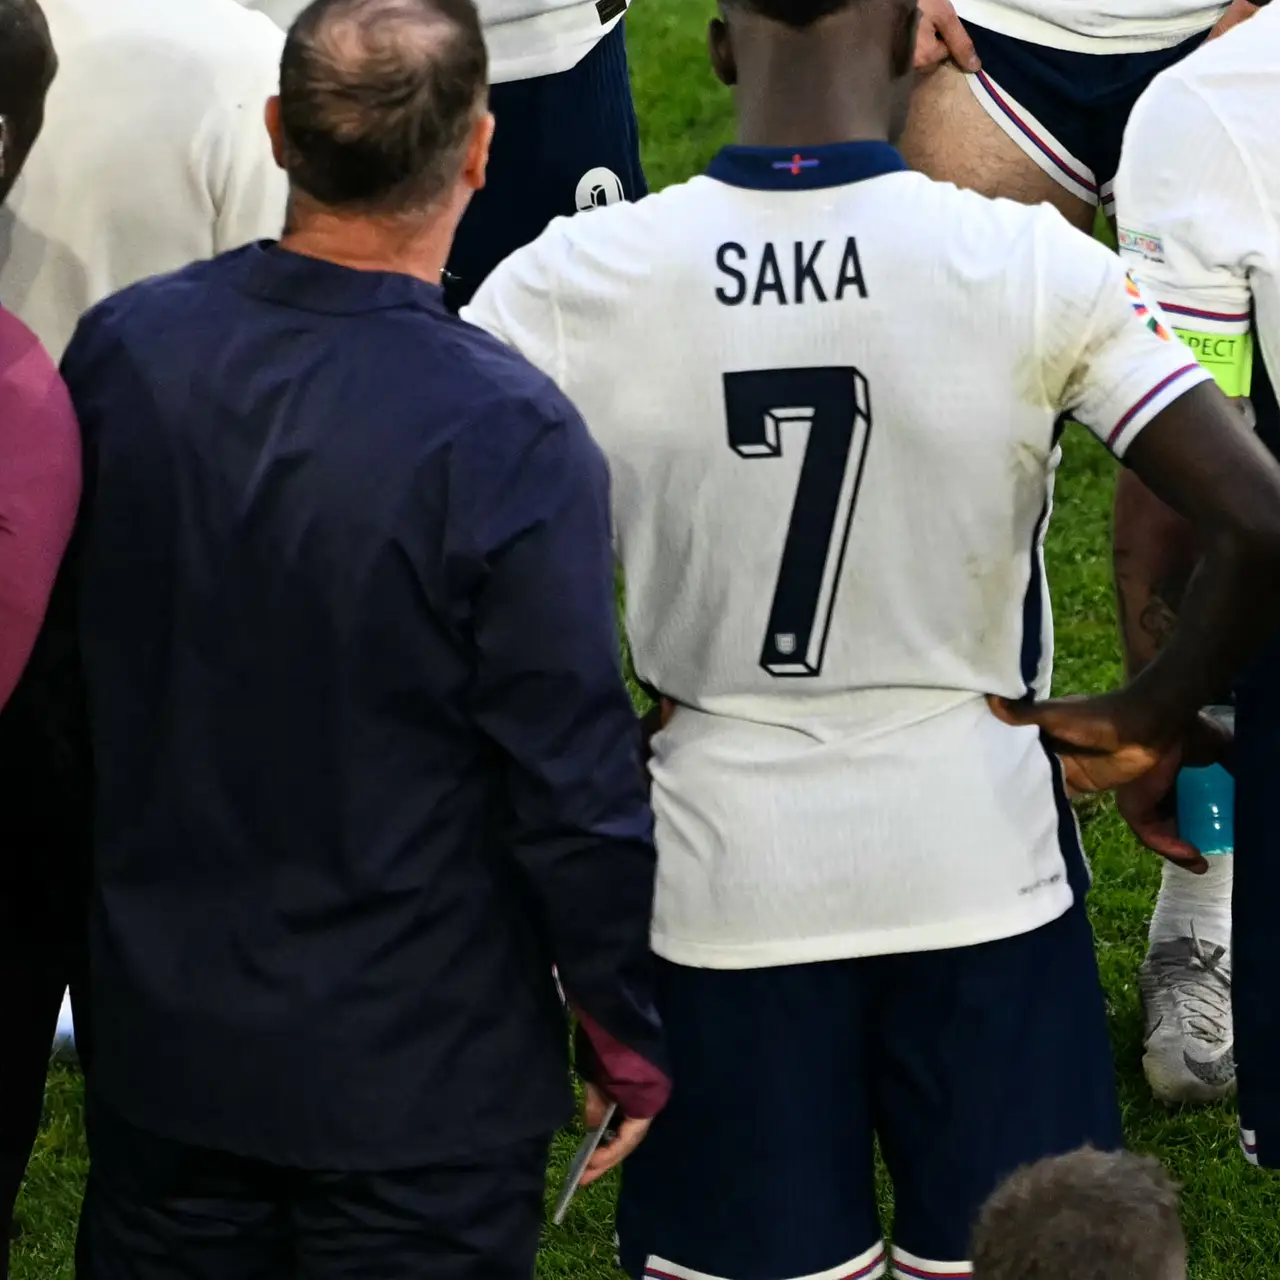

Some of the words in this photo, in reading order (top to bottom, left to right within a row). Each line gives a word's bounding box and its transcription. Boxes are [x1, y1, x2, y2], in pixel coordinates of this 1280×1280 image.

[714, 236, 869, 307] SAKA
[1178, 333, 1236, 357] PECT
[723, 366, 873, 678] 7
